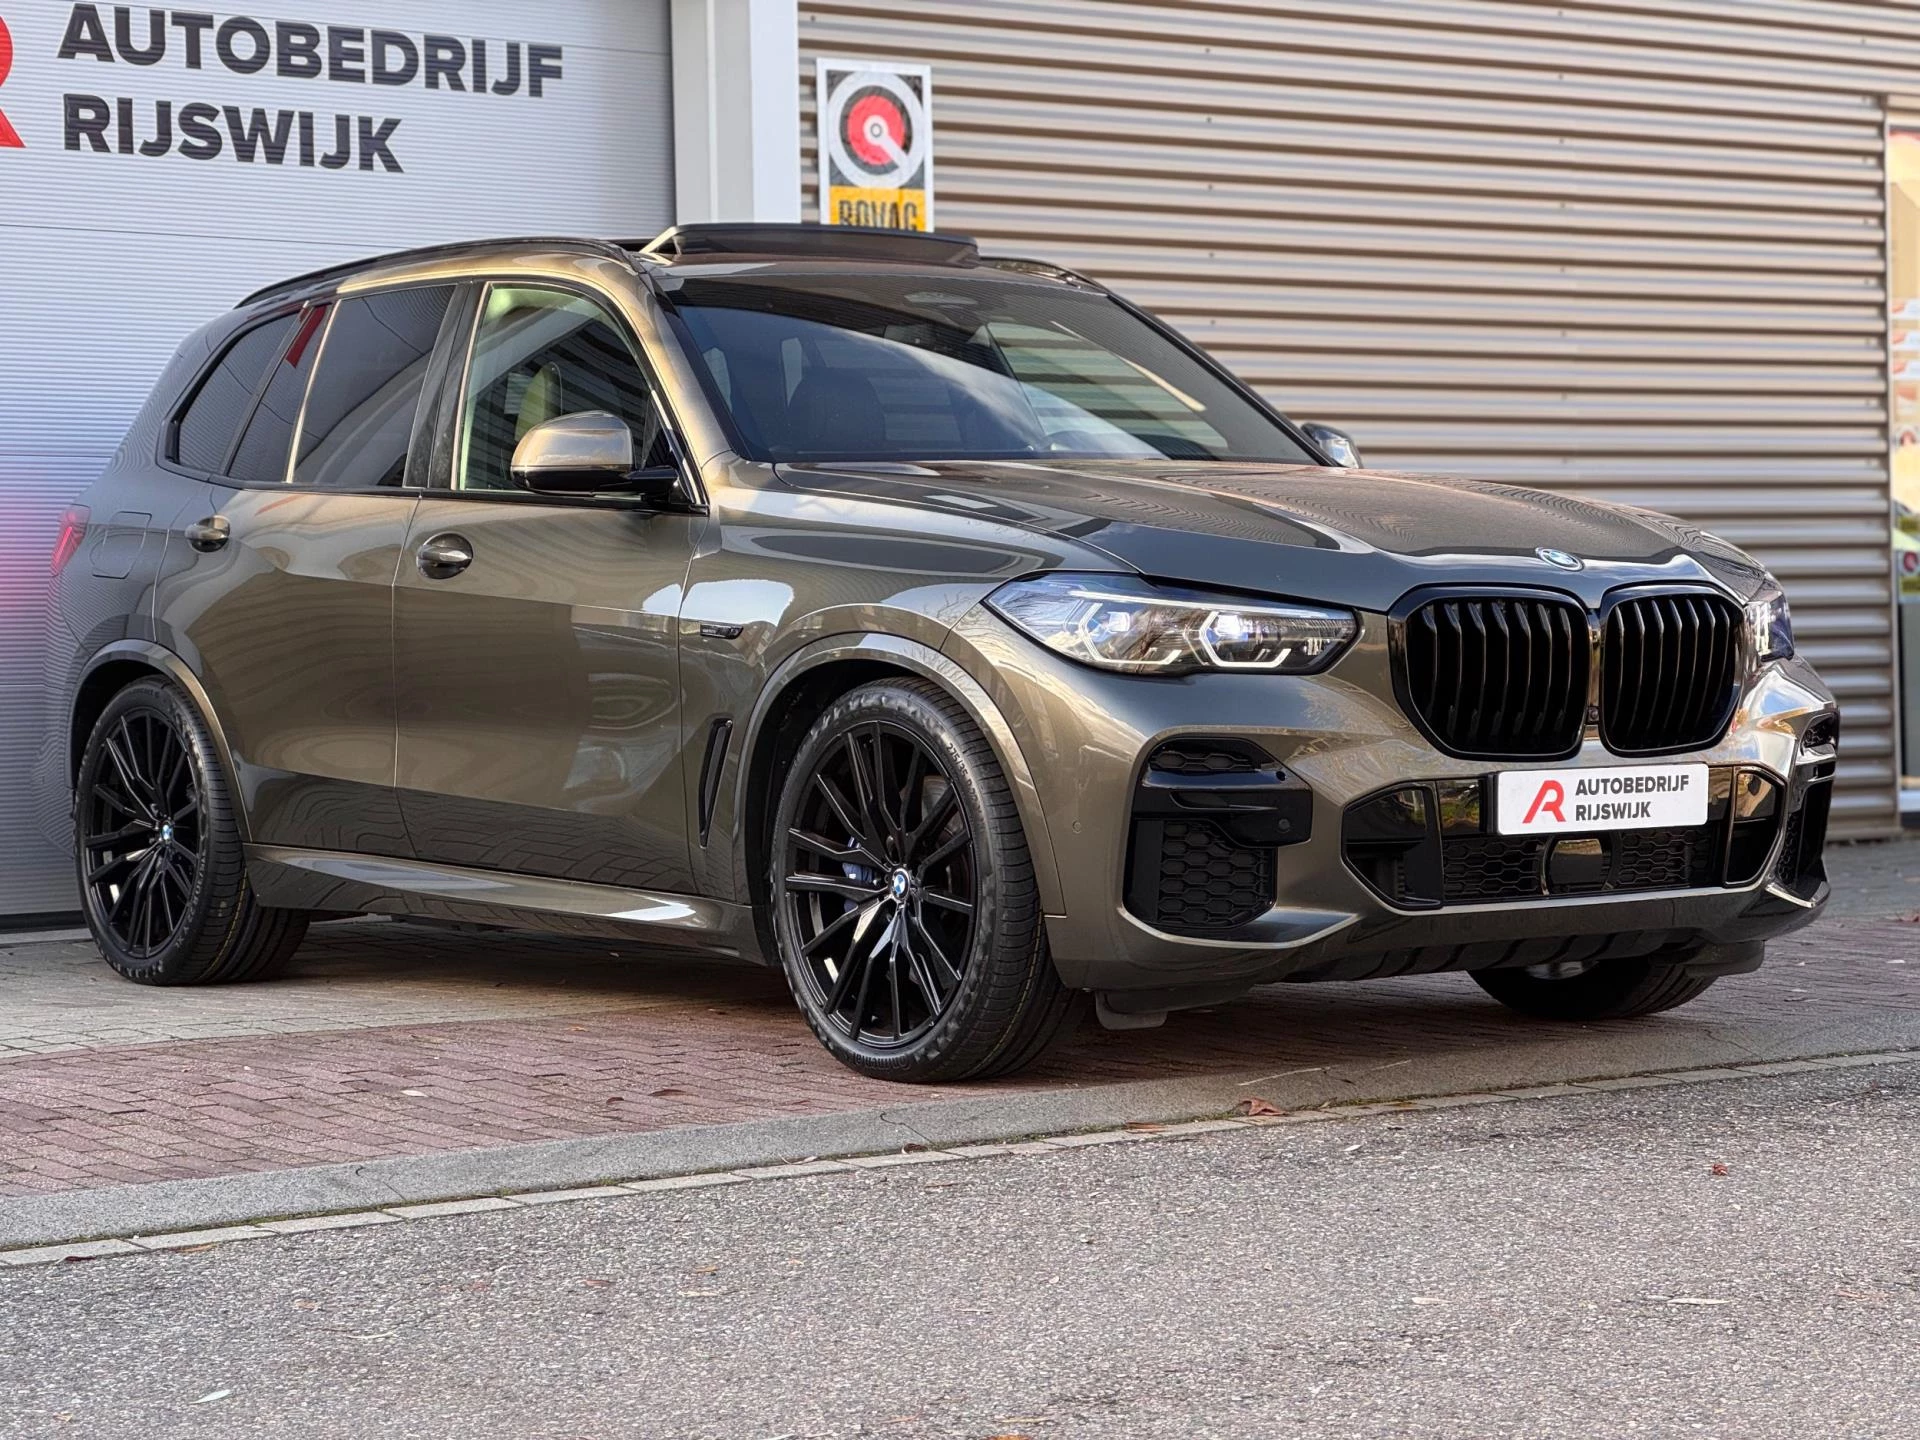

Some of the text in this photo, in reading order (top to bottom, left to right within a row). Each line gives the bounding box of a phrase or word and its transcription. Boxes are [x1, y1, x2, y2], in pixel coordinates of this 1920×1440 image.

[57, 3, 563, 97] AUTOBEDRIJF
[63, 93, 404, 173] RIJSWIJK
[838, 198, 917, 230] BOVAG
[1575, 774, 1689, 796] AUTOBEDRIJF
[1575, 801, 1651, 821] RIJSWIJK
